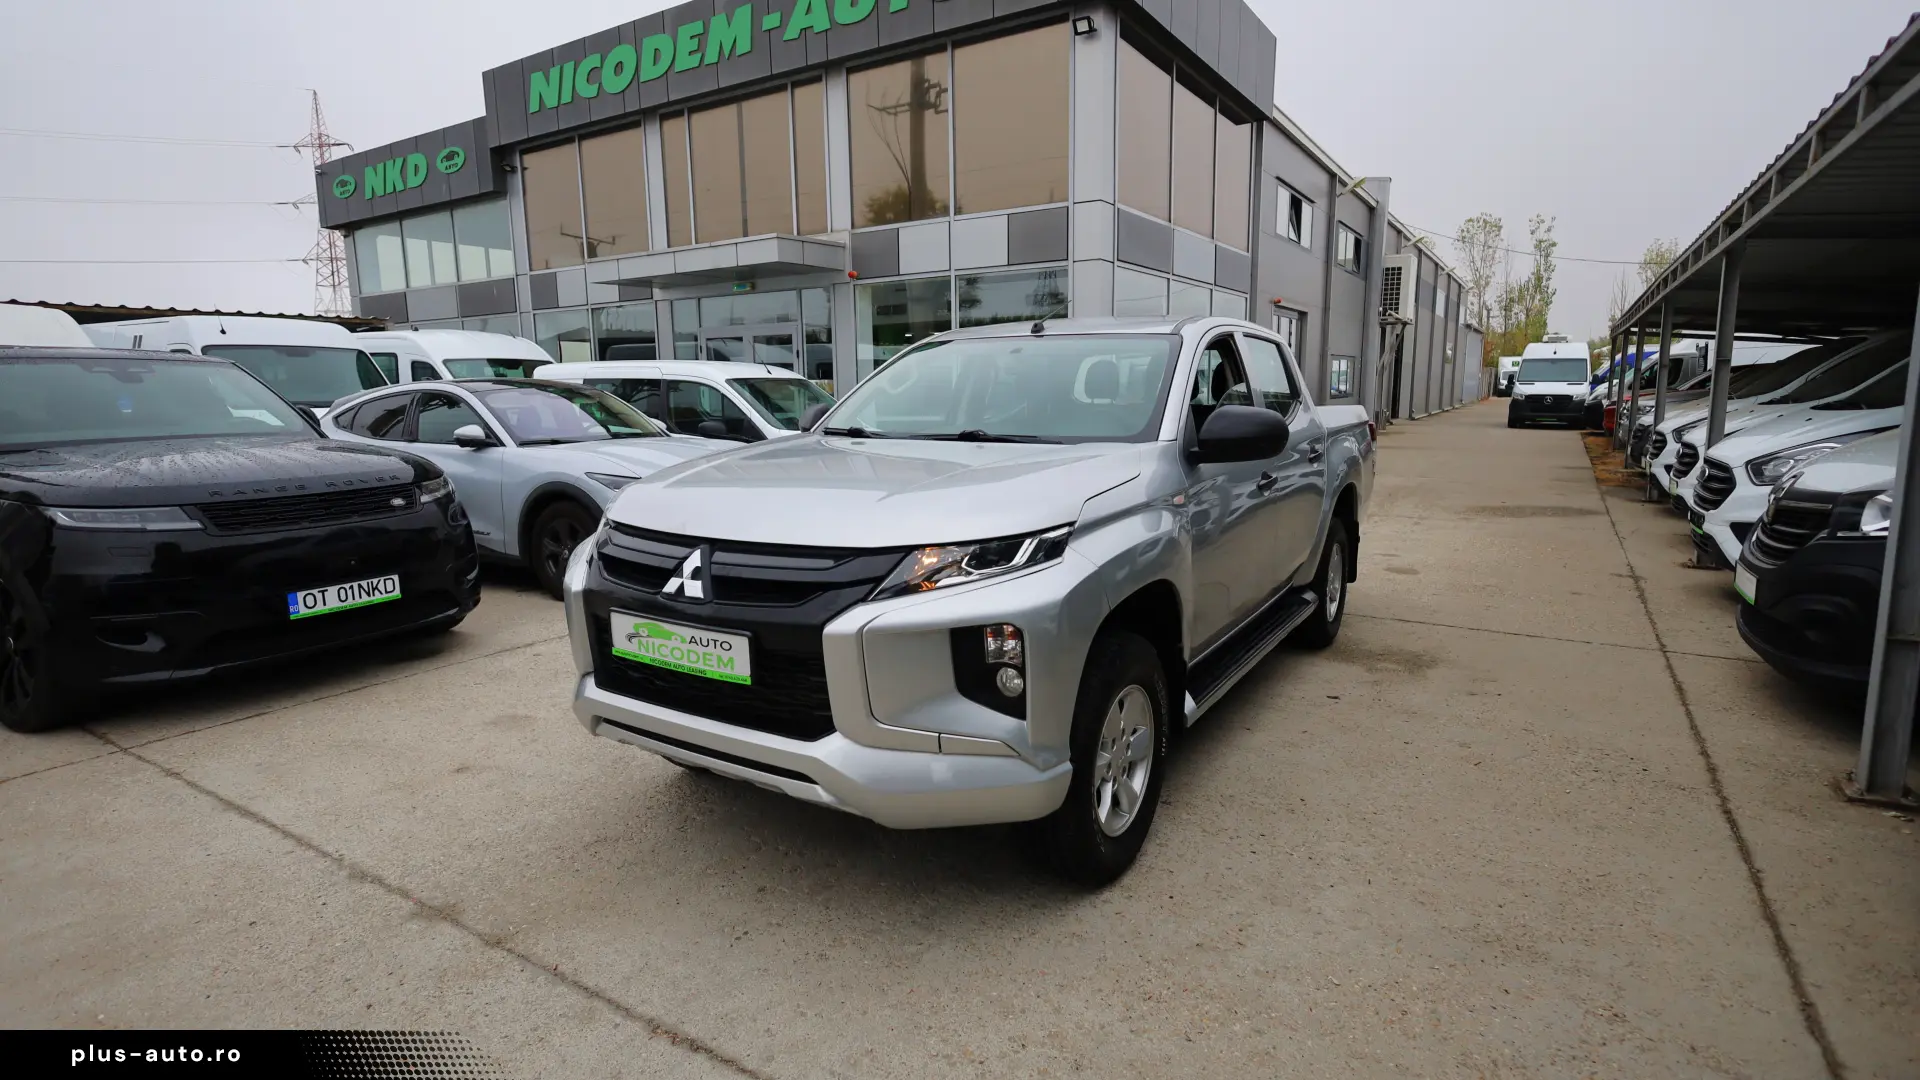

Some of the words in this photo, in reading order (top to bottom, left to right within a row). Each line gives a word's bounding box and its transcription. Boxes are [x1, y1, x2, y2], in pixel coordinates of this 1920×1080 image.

[529, 0, 909, 114] NICODEM-AU
[364, 153, 429, 200] NKD
[208, 483, 307, 498] RANGE
[325, 474, 401, 489] ROVER
[289, 605, 299, 613] RO
[302, 588, 329, 610] OT
[337, 577, 396, 603] 01NKD
[637, 638, 736, 672] NICODEM
[688, 635, 733, 652] AUTO
